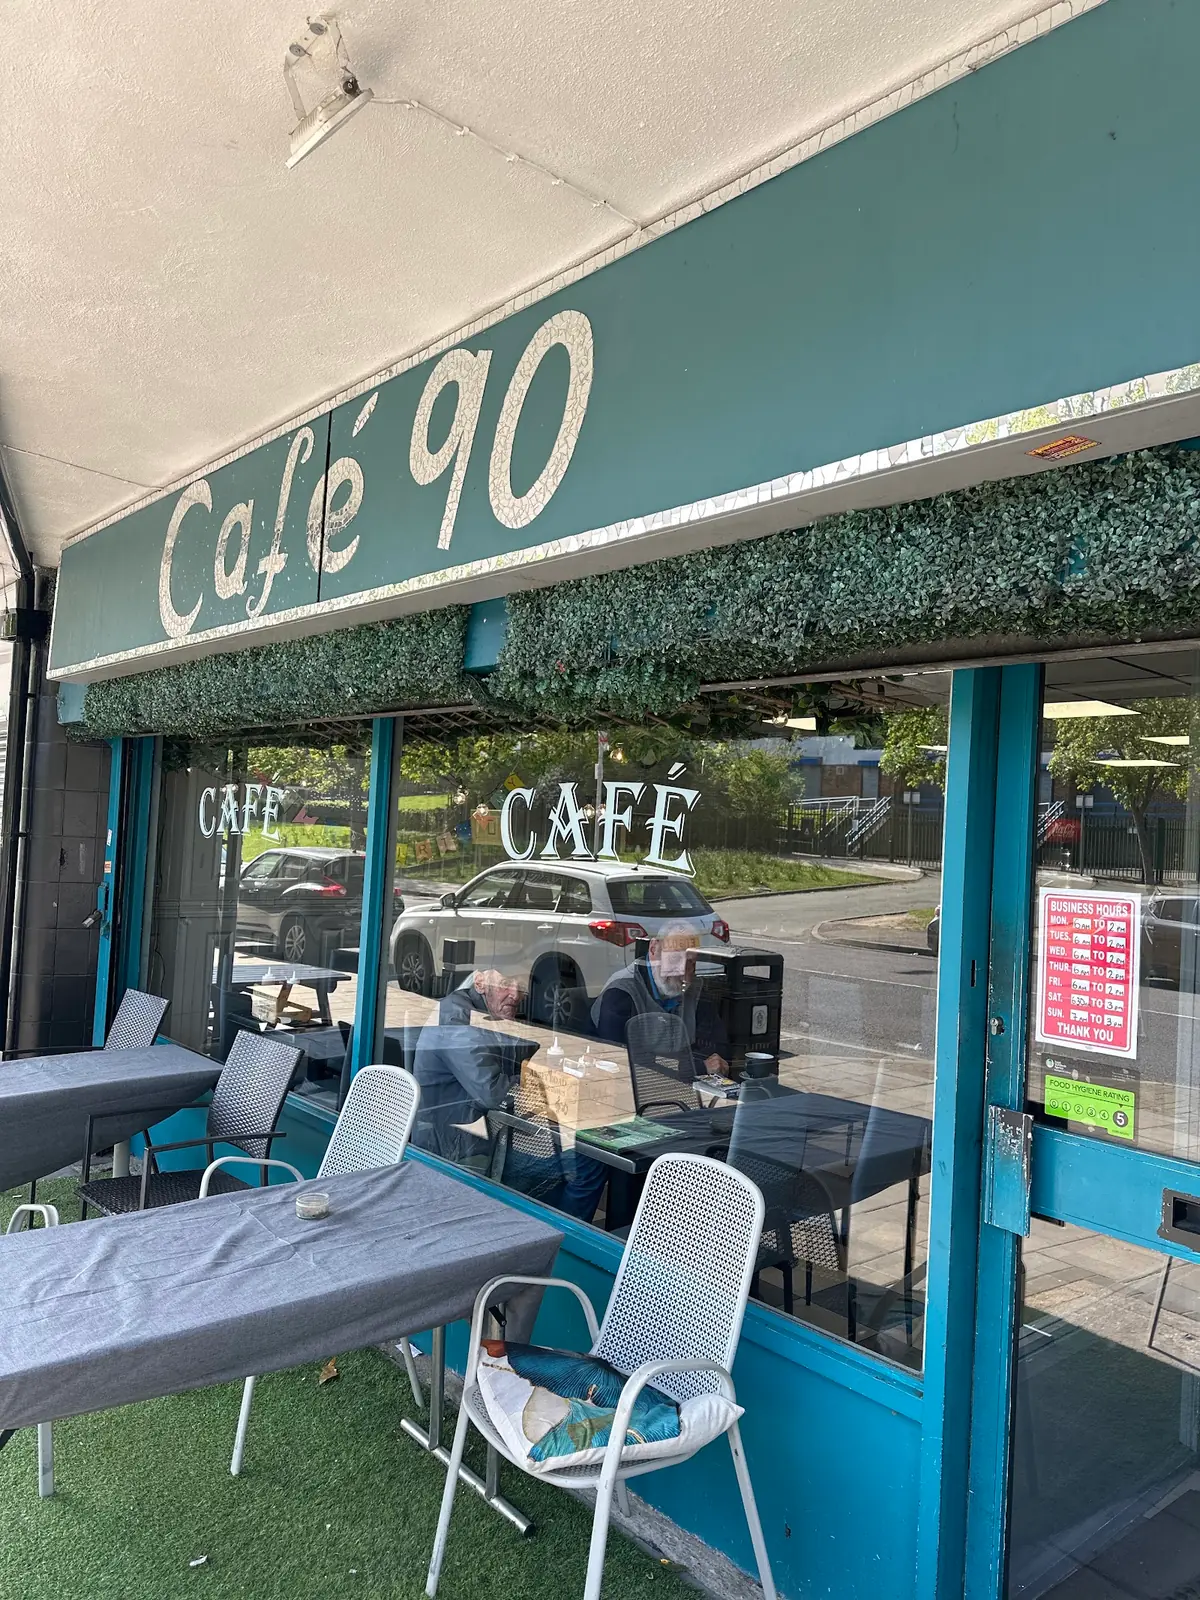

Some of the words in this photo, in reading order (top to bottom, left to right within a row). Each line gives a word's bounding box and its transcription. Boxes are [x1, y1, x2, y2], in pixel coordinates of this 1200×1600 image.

[157, 391, 379, 638] Café
[409, 309, 594, 550] 90
[199, 770, 284, 844] CAFÉ
[500, 762, 701, 878] CAFÉ
[1050, 900, 1094, 914] BUSINESS
[1096, 904, 1128, 917] HOURS
[1050, 915, 1069, 925] MON.
[1093, 919, 1106, 928] TO
[1049, 930, 1071, 941] TUES.
[1092, 935, 1106, 944] TO
[1049, 945, 1068, 956] WED.
[1092, 951, 1105, 960] TO
[1048, 961, 1072, 973] THUR.
[1092, 966, 1105, 976] TO
[1048, 976, 1063, 987] FRI.
[1091, 982, 1104, 992] TO
[1048, 992, 1063, 1002] SAT.
[1090, 998, 1103, 1008] TO
[1047, 1007, 1065, 1018] SUN.
[1090, 1014, 1103, 1024] TO
[1057, 1021, 1091, 1038] THANK
[1093, 1028, 1114, 1042] YOU
[1049, 1080, 1071, 1089] FOOD
[1072, 1084, 1102, 1097] HYGIENE
[1103, 1091, 1130, 1103] RATING
[1116, 1112, 1125, 1126] 5
